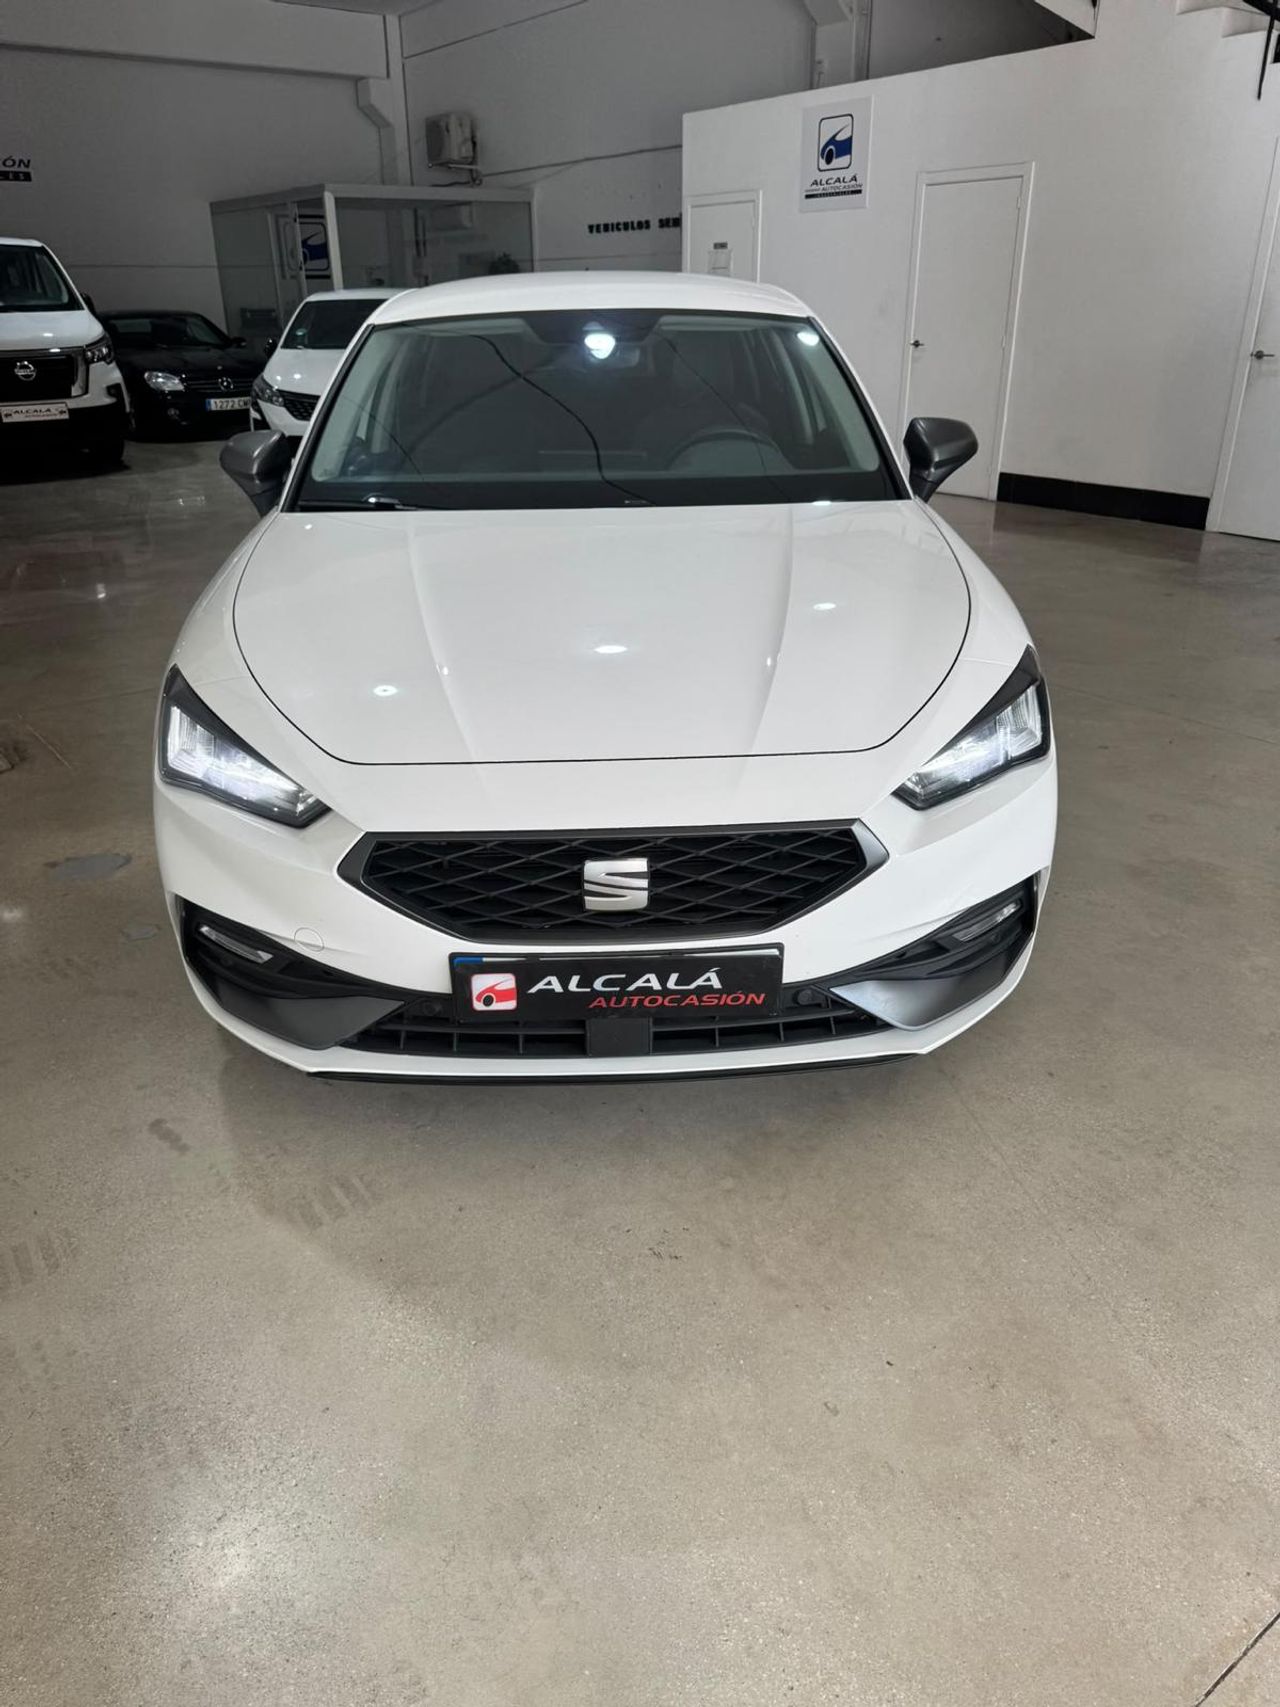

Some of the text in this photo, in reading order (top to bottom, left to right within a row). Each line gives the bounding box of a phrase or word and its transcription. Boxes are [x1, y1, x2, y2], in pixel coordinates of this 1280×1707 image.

[810, 174, 859, 188] ALCALÁ
[213, 400, 235, 409] 1272
[527, 967, 723, 994] ALCALÁ
[588, 991, 766, 1009] AUTOCASIÓN
